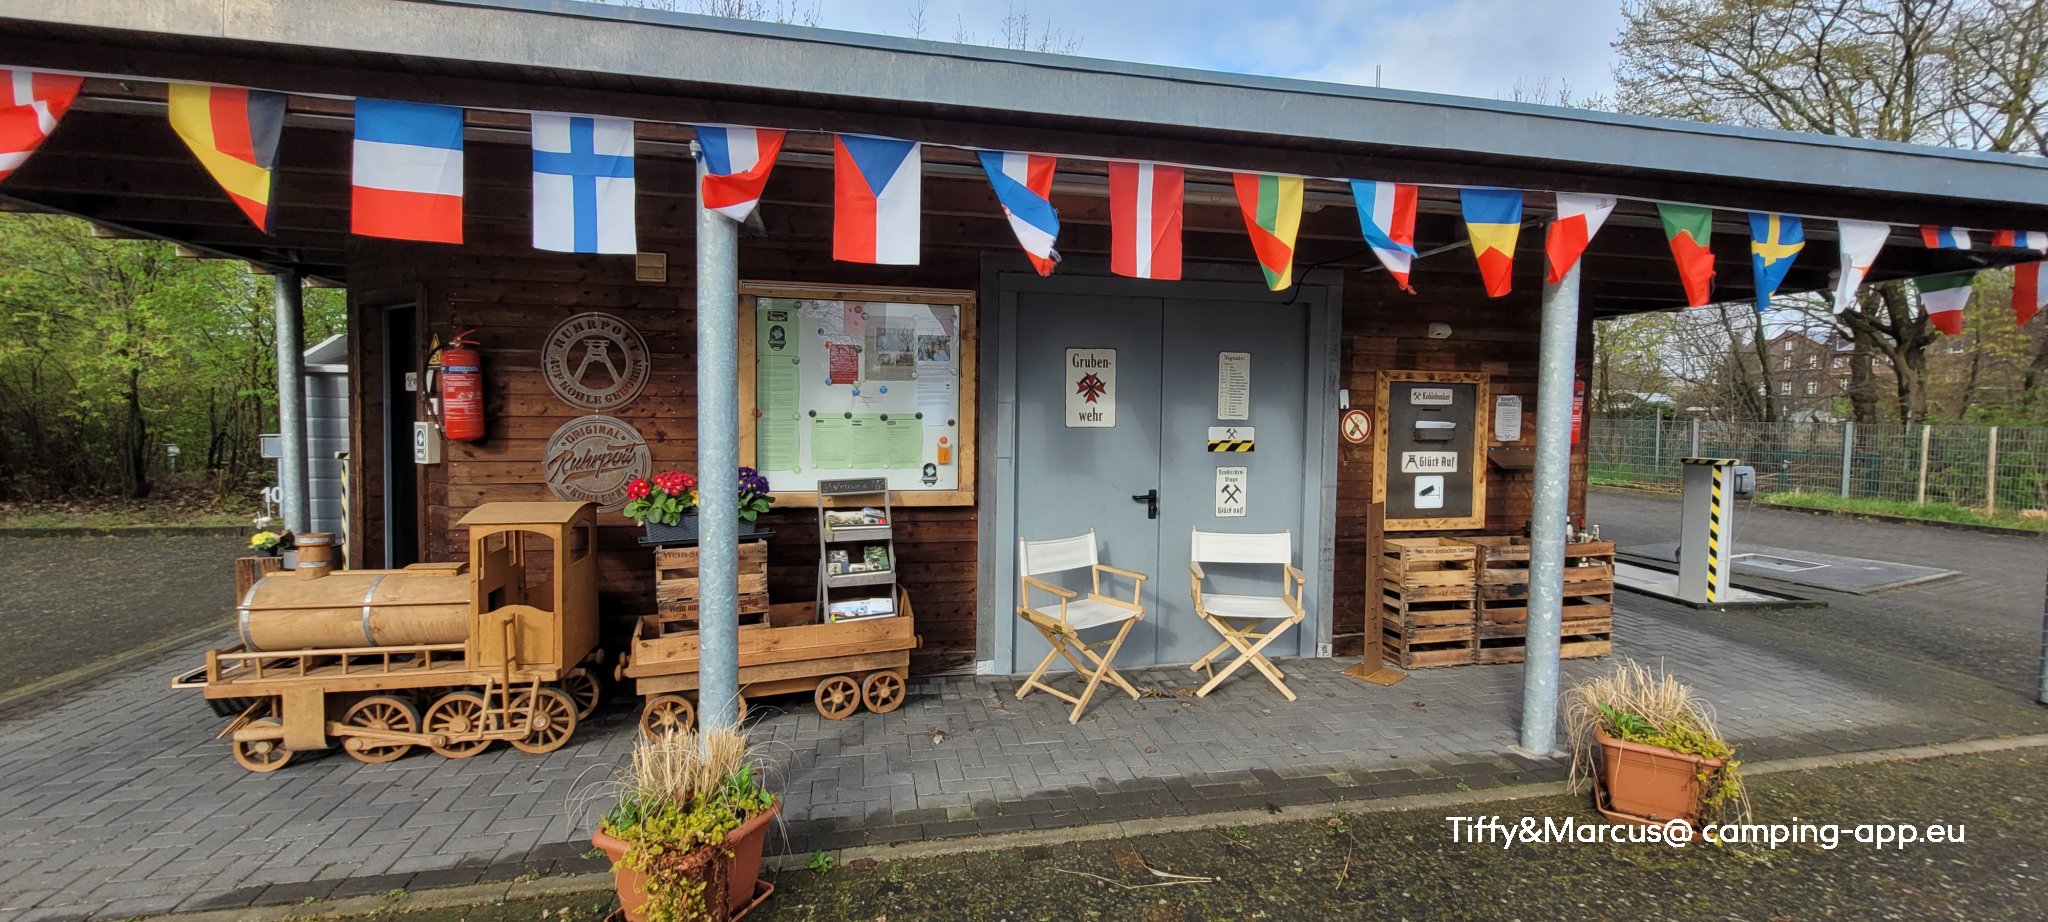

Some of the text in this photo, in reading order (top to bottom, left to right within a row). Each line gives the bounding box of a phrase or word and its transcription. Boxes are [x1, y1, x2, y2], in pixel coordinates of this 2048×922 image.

[553, 319, 641, 352] RUHRPOTT
[1072, 353, 1112, 369] Gruben-
[550, 356, 643, 405] AUF KOHLE GEBOREN
[1078, 407, 1103, 422] wehr
[565, 424, 620, 445] ORIGINAL
[1419, 456, 1456, 468] Glück Auf
[260, 486, 284, 503] 10
[662, 550, 688, 559] Wein
[669, 604, 686, 613] Wein
[739, 597, 758, 606] anden
